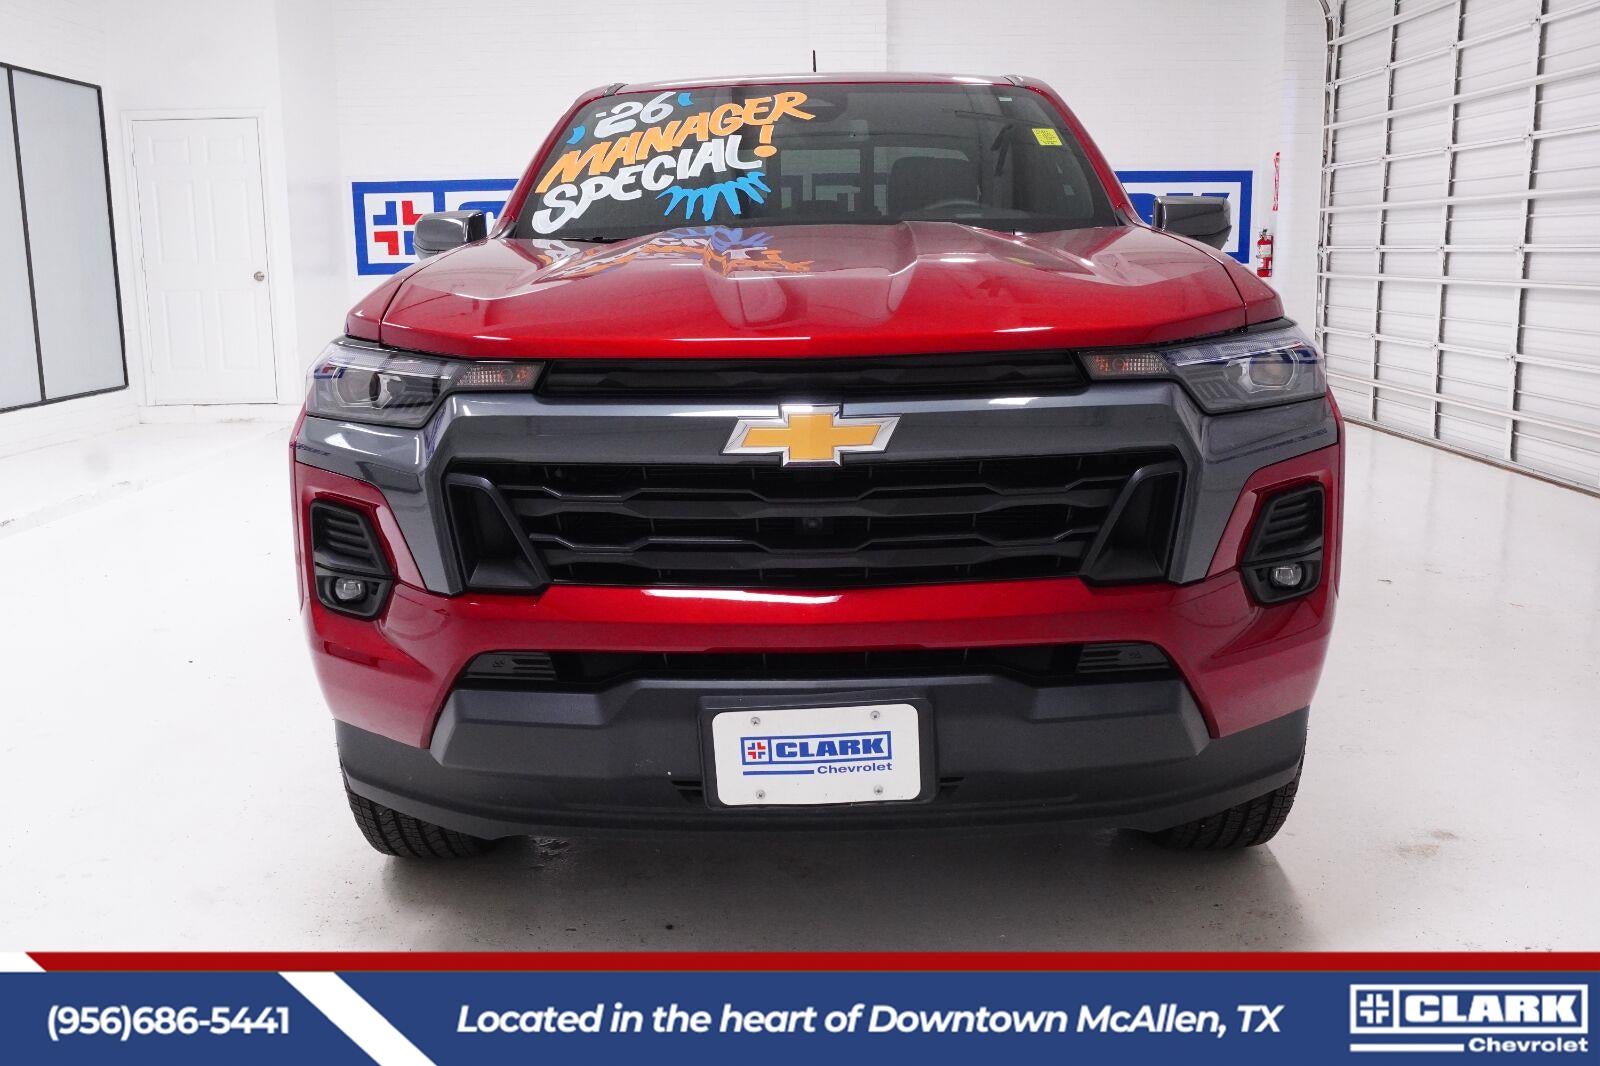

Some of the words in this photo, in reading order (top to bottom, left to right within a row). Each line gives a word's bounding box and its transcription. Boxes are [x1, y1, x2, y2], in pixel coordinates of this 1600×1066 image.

[535, 91, 816, 194] MANAGER
[776, 738, 884, 758] CLARK
[817, 762, 893, 775] Chevrolet
